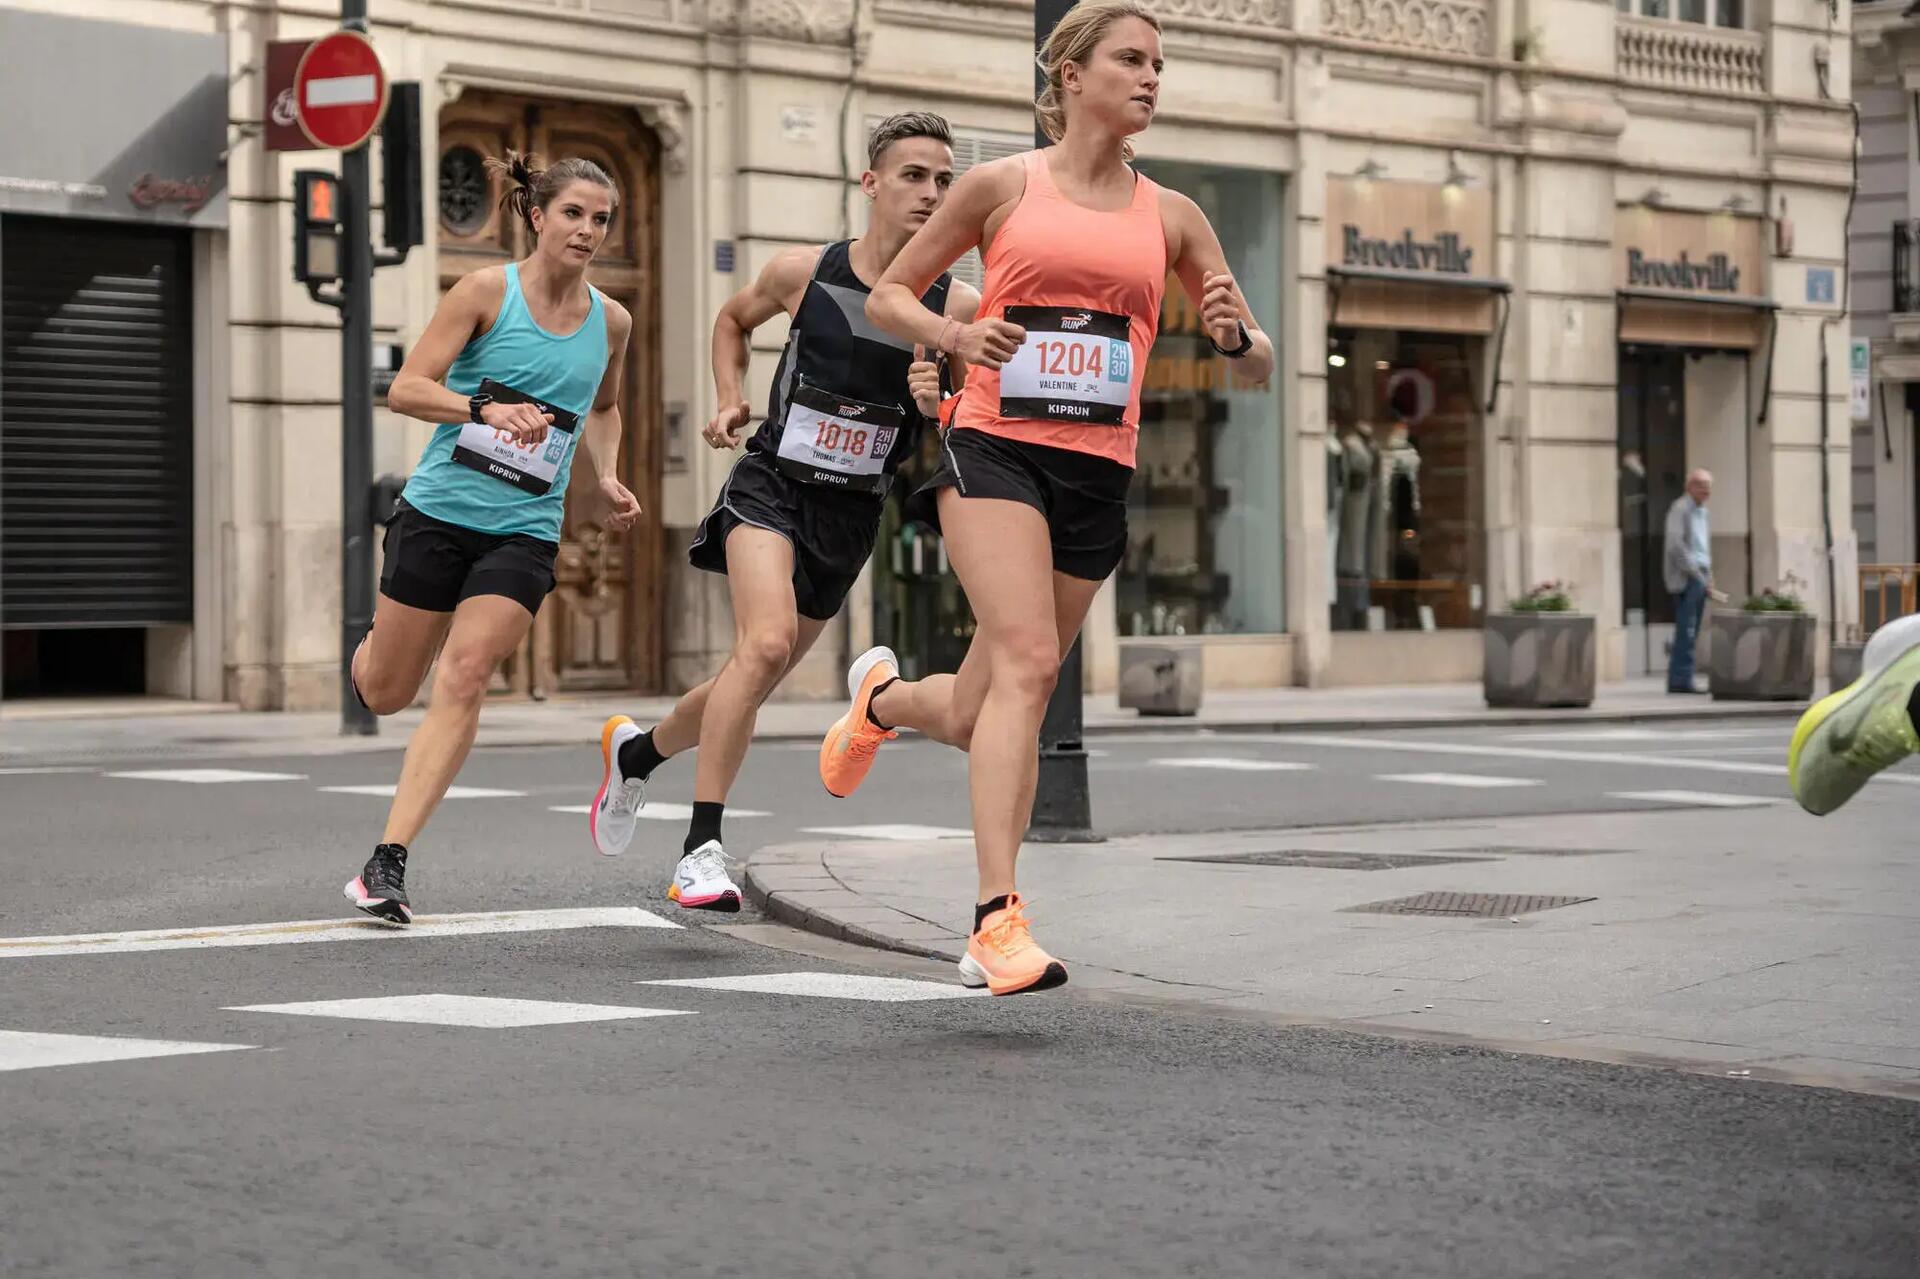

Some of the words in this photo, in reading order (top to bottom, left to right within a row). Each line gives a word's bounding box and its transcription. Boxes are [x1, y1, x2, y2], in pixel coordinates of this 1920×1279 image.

[1342, 223, 1473, 273] Brookville
[1626, 246, 1740, 293] Brookville
[1111, 343, 1127, 359] 2H
[1036, 341, 1102, 378] 1204
[1111, 360, 1127, 377] 30
[1039, 380, 1077, 391] VALENTINE
[1048, 404, 1090, 416] KIPRUN
[552, 432, 567, 447] 2H
[816, 420, 868, 456] 1018
[877, 429, 892, 442] 2H
[547, 446, 560, 459] 45
[873, 442, 888, 455] 30
[813, 450, 836, 463] THOMAS
[489, 463, 521, 482] KIPRUN
[814, 471, 848, 484] KIPRUN
